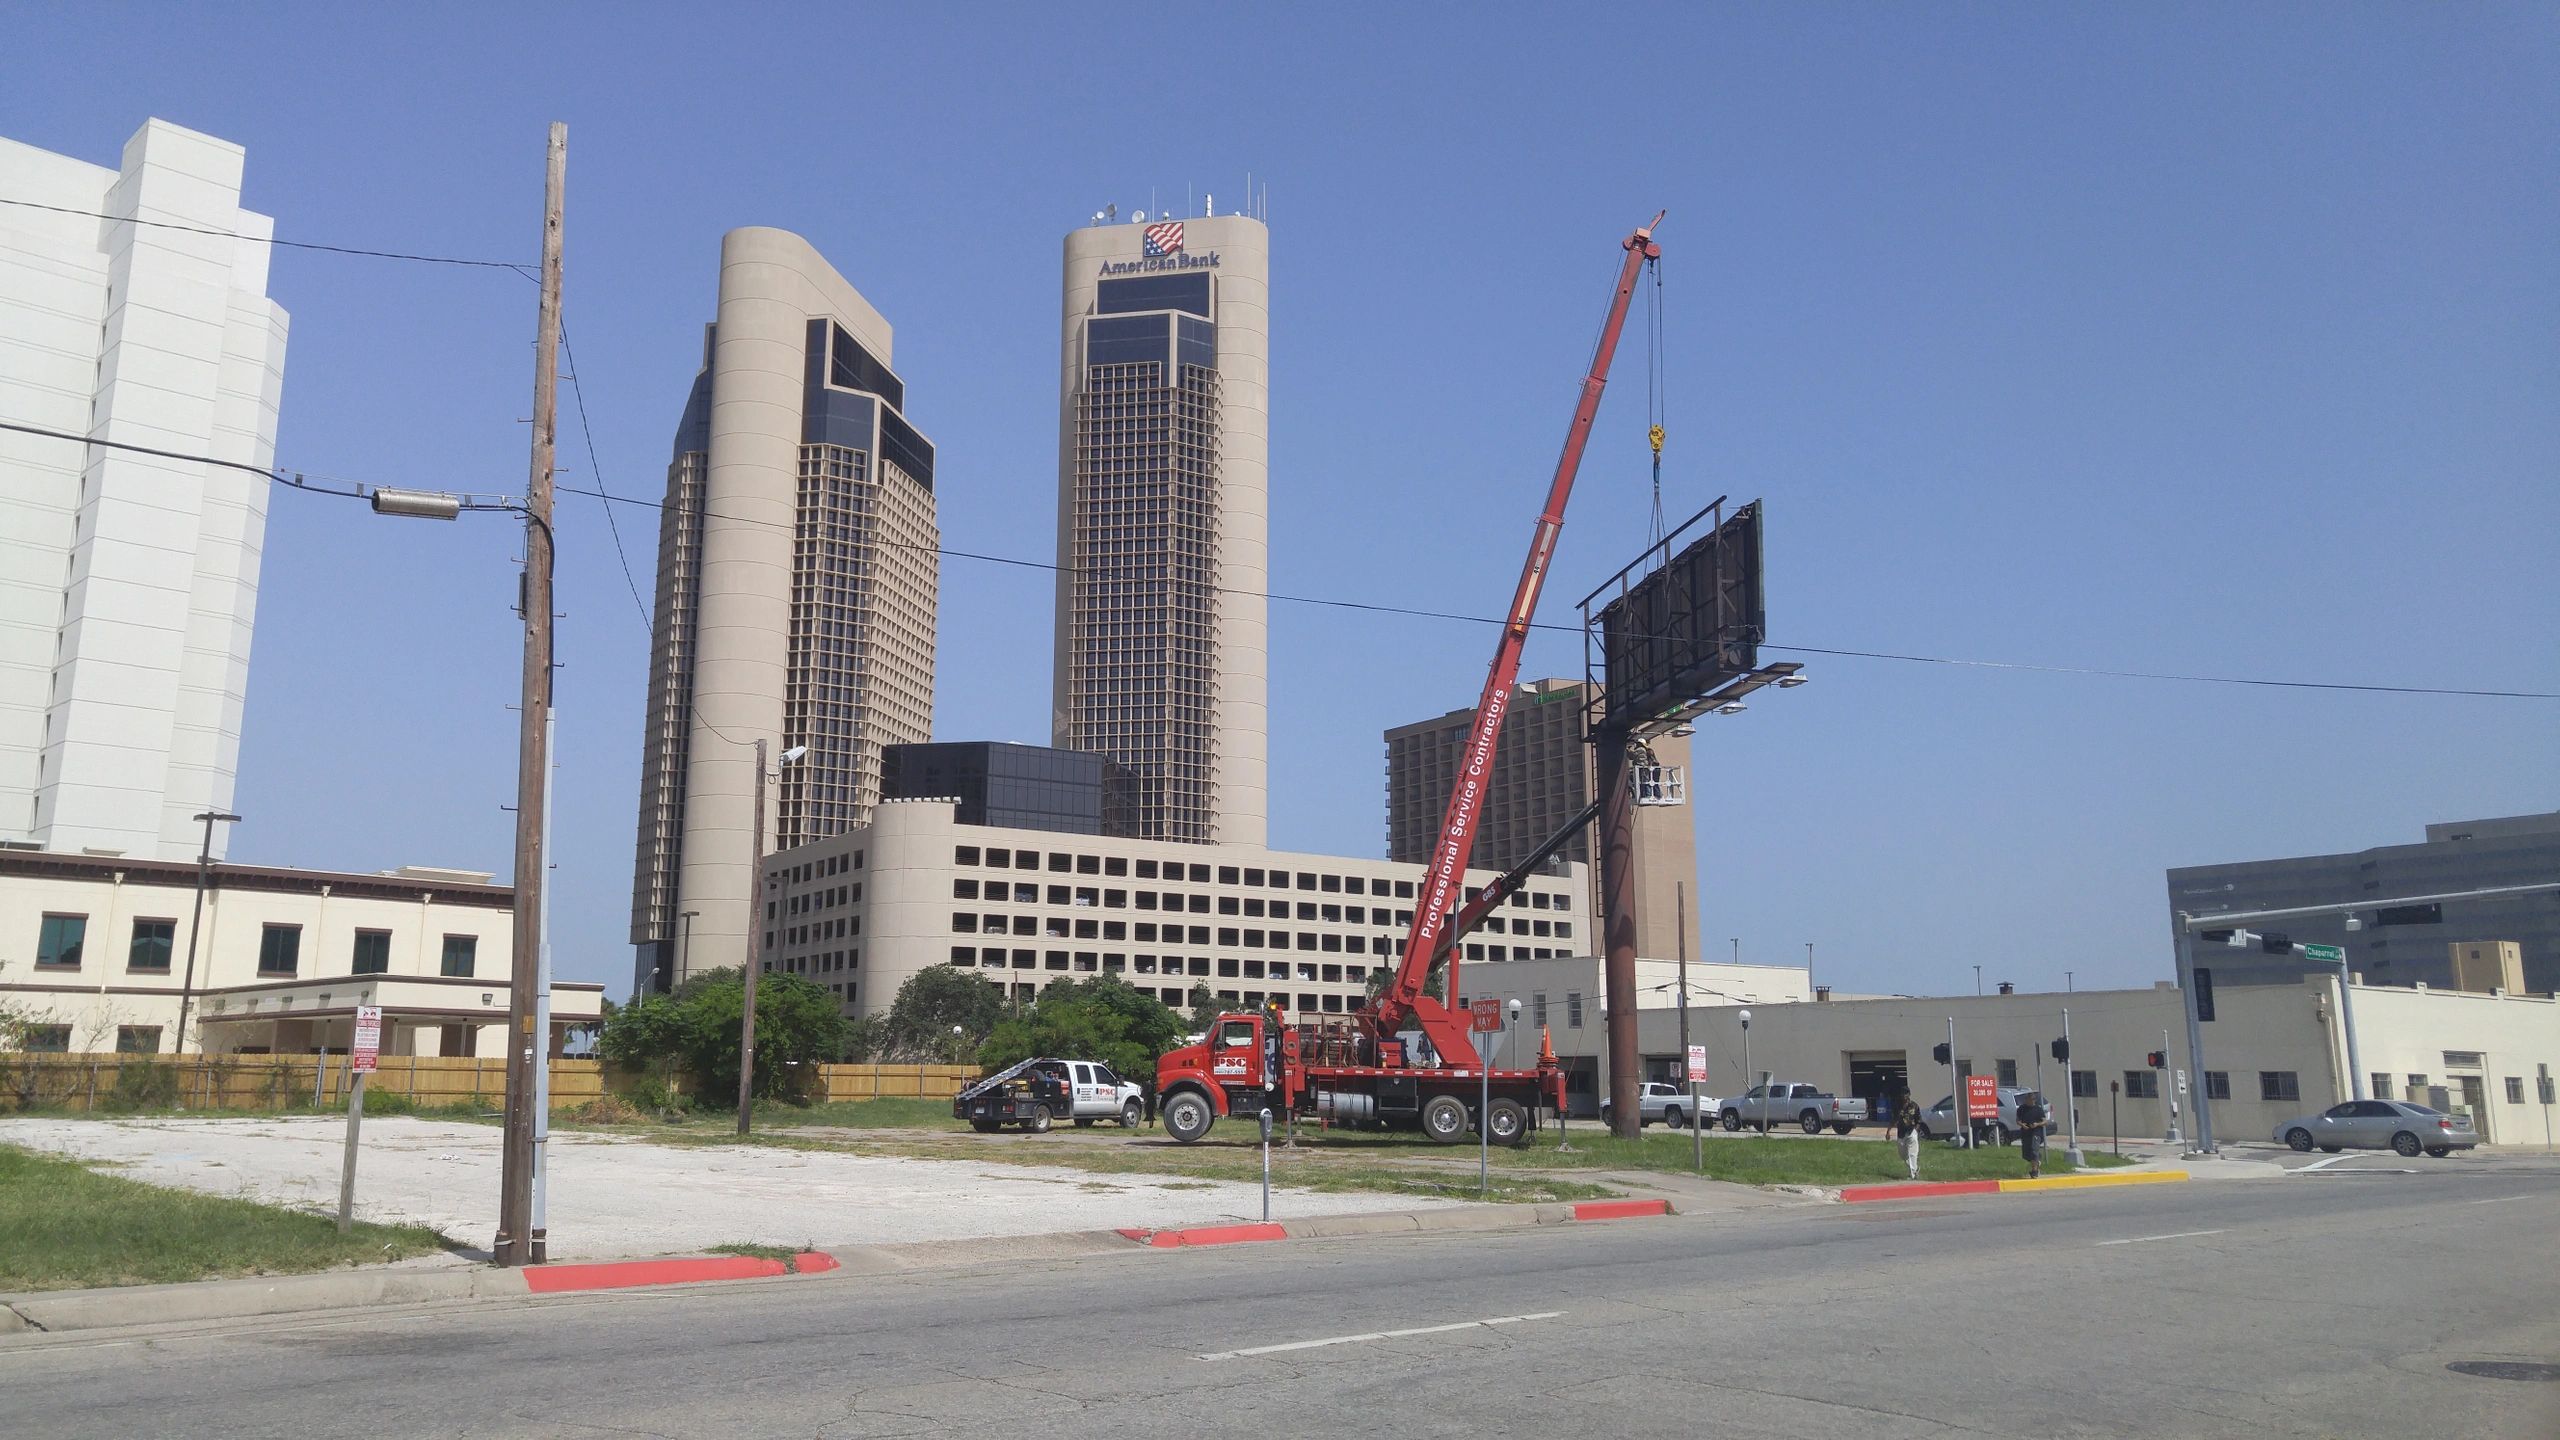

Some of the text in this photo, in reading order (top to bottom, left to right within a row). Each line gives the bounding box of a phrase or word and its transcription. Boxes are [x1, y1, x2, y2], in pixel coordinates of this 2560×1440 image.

[1420, 688, 1505, 940] Professional Service Contractors
[2307, 946, 2335, 958] Chaparral
[1473, 1003, 1497, 1015] WRONG
[1477, 1016, 1492, 1027] WAY
[1214, 1058, 1246, 1067] PSC
[1970, 1079, 1994, 1087] FOR SALE
[1099, 1088, 1116, 1096] PSC
